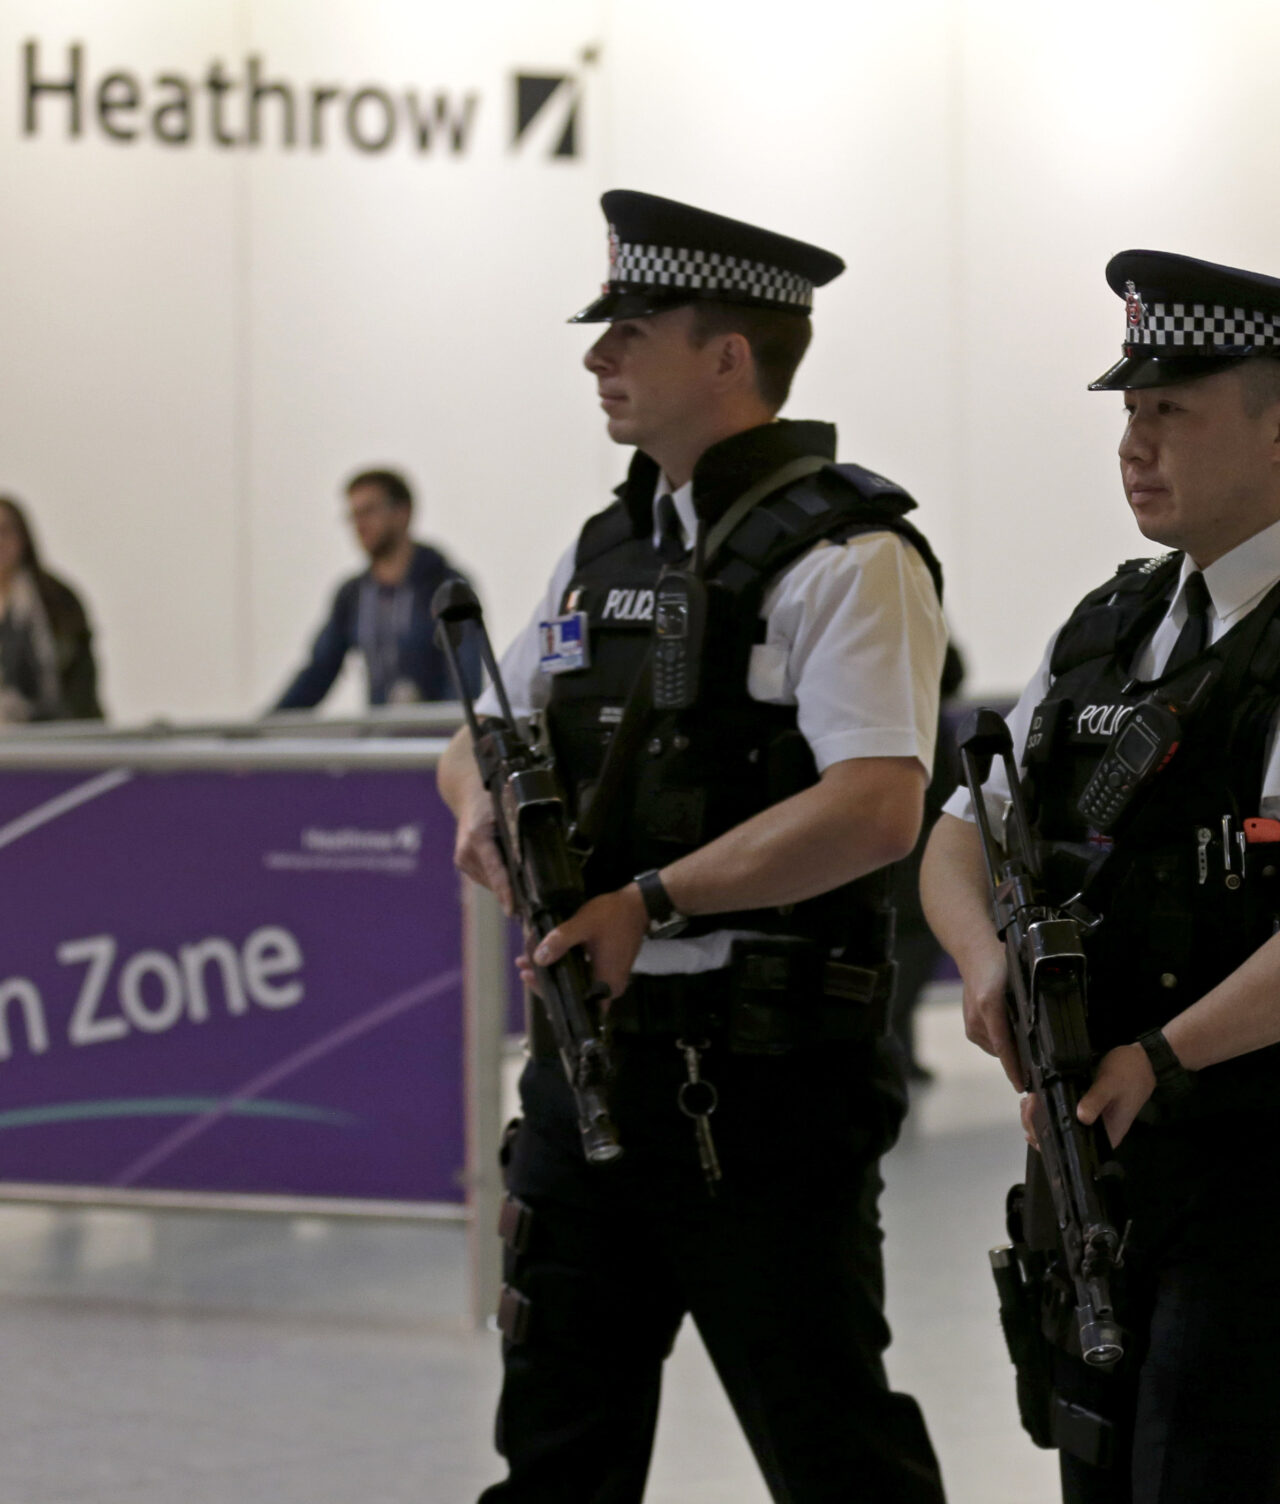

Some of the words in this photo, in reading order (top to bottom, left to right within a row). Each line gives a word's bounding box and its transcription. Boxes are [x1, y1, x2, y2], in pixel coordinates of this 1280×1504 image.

[20, 37, 479, 157] Heathrow
[1077, 705, 1134, 735] POLIC
[56, 924, 305, 1046] Zone
